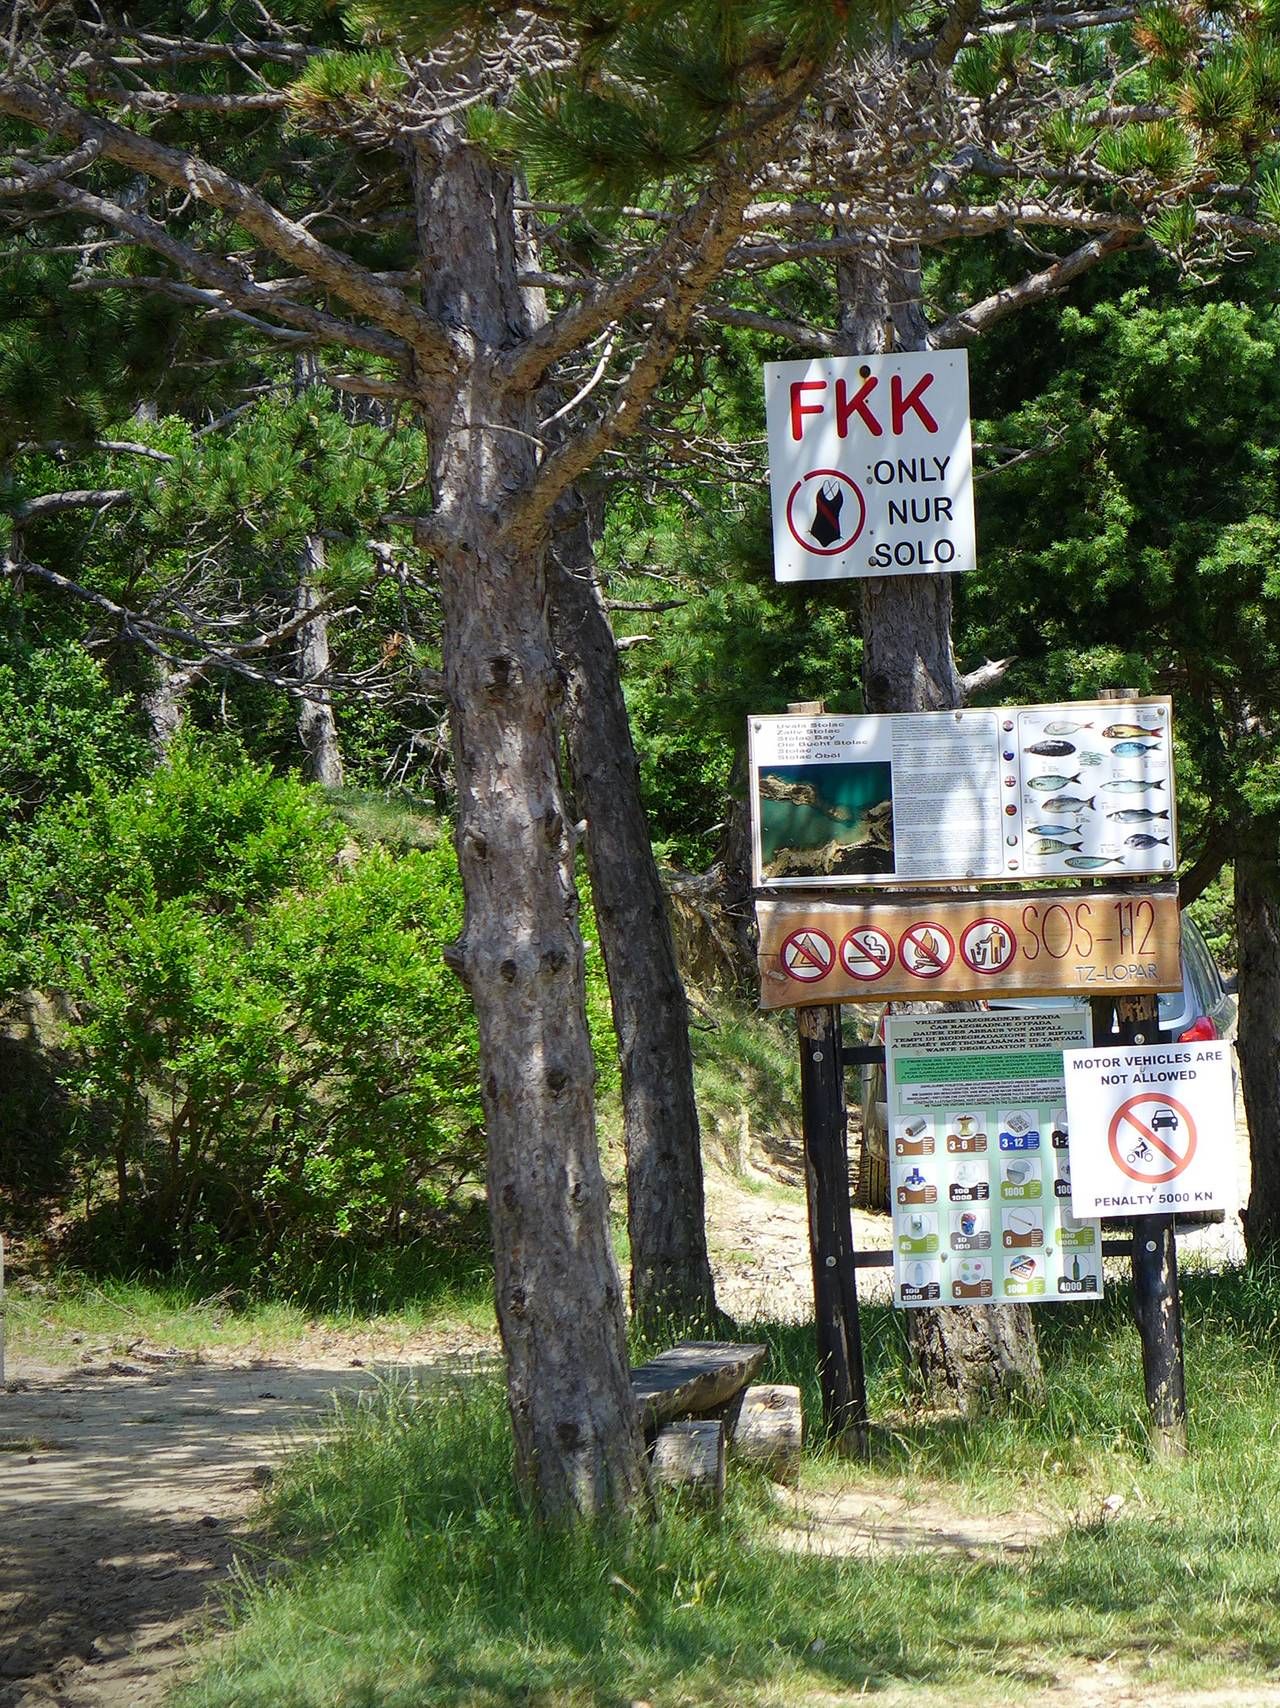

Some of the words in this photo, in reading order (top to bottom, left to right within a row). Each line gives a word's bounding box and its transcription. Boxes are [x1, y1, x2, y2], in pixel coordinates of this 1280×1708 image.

[789, 372, 939, 441] FKK
[874, 456, 951, 485] ONLY
[889, 497, 953, 525] NUR
[875, 539, 955, 568] SOLO
[1075, 963, 1158, 981] TZ-LOPAR
[951, 1021, 1012, 1029] RAZGRADNJE
[959, 1015, 1021, 1023] RAZGRADNJE
[960, 1043, 1026, 1051] DEGRADATION
[1073, 1057, 1121, 1070] MOTOR
[1125, 1053, 1192, 1066] VEHICLES
[1196, 1051, 1223, 1062] ARE
[1101, 1074, 1128, 1085] NOT
[1132, 1070, 1197, 1083] ALLOWED
[1095, 1194, 1155, 1207] PENALTY
[1158, 1192, 1190, 1204] 5000
[1194, 1192, 1213, 1201] KN
